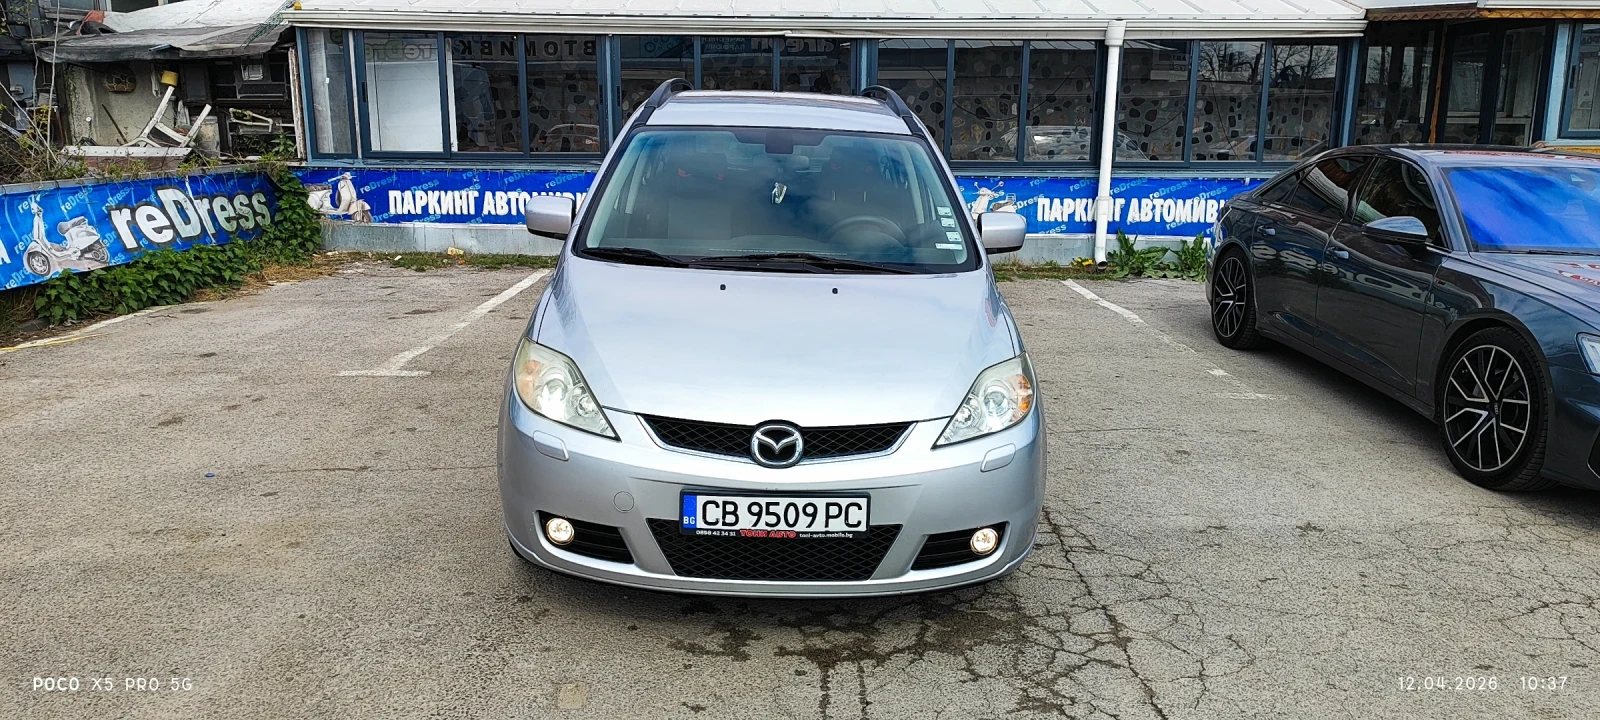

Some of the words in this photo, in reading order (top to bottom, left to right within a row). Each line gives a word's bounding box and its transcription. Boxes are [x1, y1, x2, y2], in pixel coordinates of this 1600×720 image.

[388, 190, 480, 215] ПАРКИНГ
[1148, 180, 1189, 200] reDress
[109, 187, 272, 250] reDress
[1127, 197, 1227, 223] АВТОМИВ
[683, 516, 696, 525] BG
[702, 500, 739, 527] CB
[747, 501, 818, 528] 9509
[824, 502, 862, 528] PC
[740, 529, 767, 538] ТОНИ
[769, 530, 796, 538] АВТО
